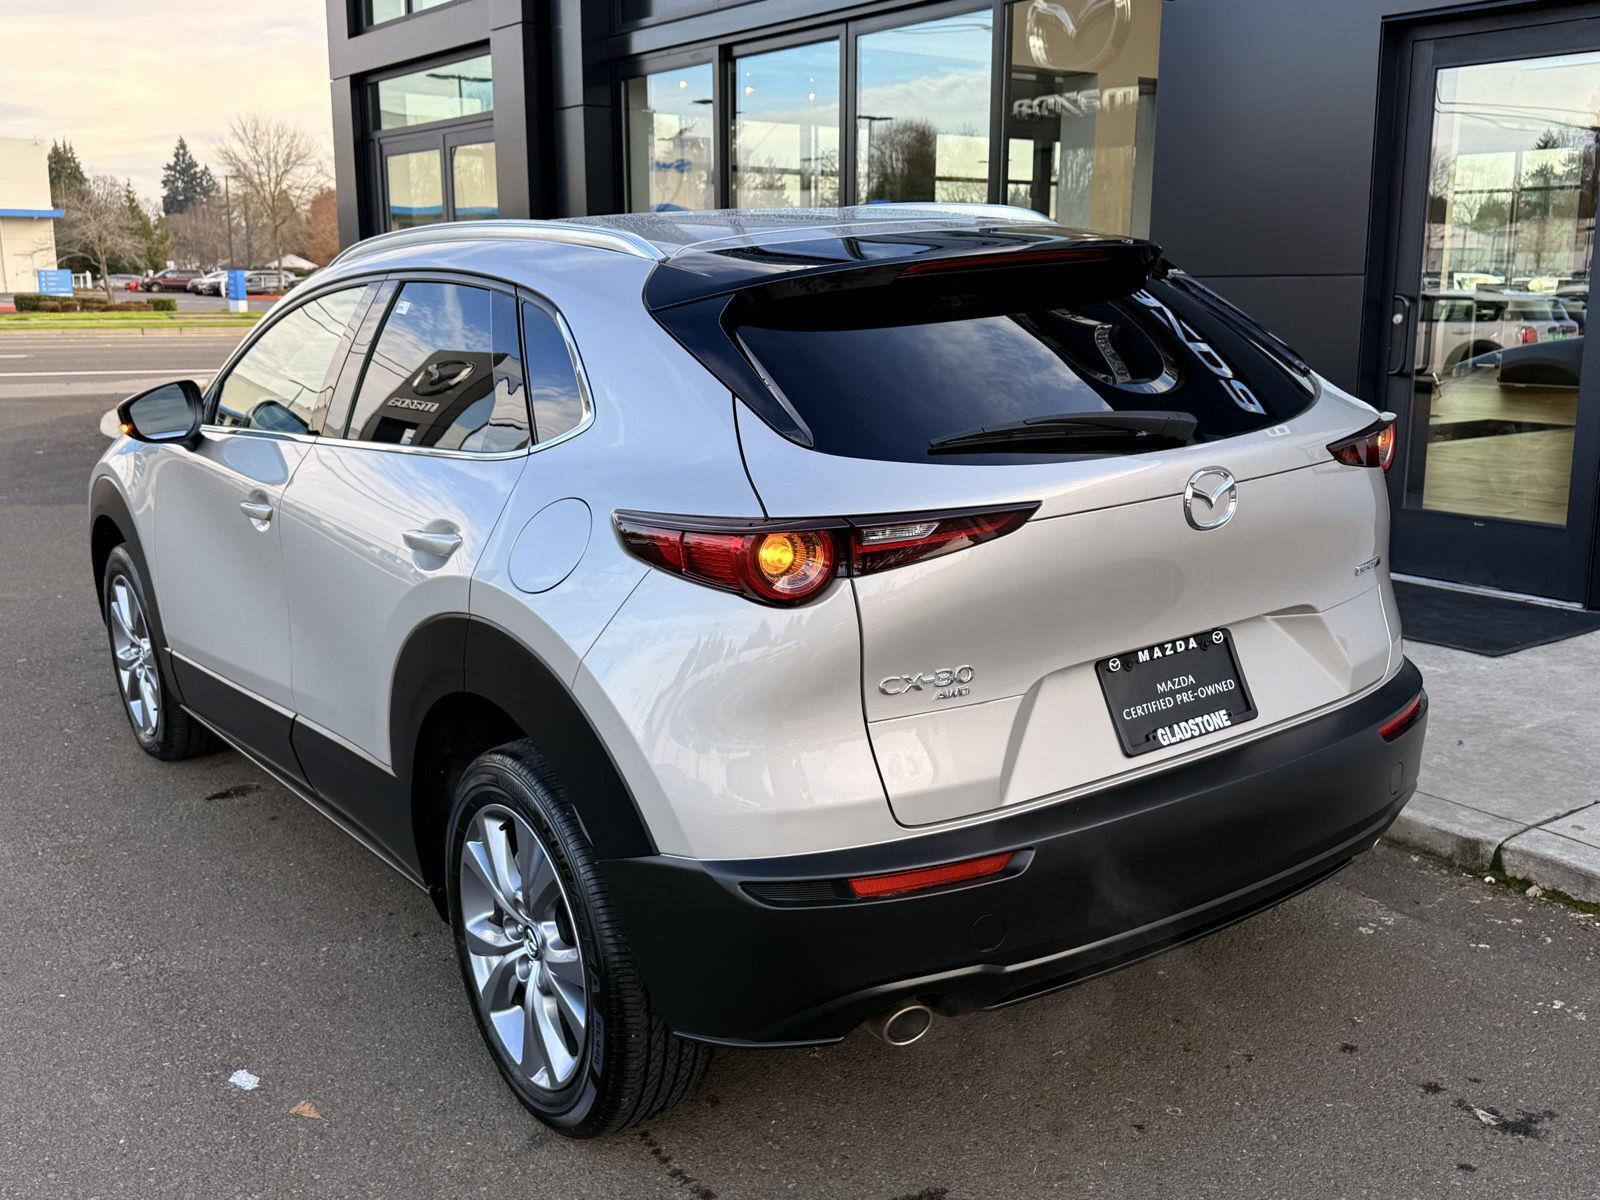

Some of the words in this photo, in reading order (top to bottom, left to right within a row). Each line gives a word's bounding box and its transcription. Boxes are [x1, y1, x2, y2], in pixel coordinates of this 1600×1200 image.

[1137, 637, 1198, 663] MAZDA
[878, 664, 975, 695] CX-30
[932, 685, 970, 701] AWD
[1156, 674, 1196, 694] MAZDA
[1122, 696, 1174, 720] CERTIFIED
[1175, 678, 1235, 705] PRE-OWNED
[1156, 709, 1231, 746] GLADSTONE
